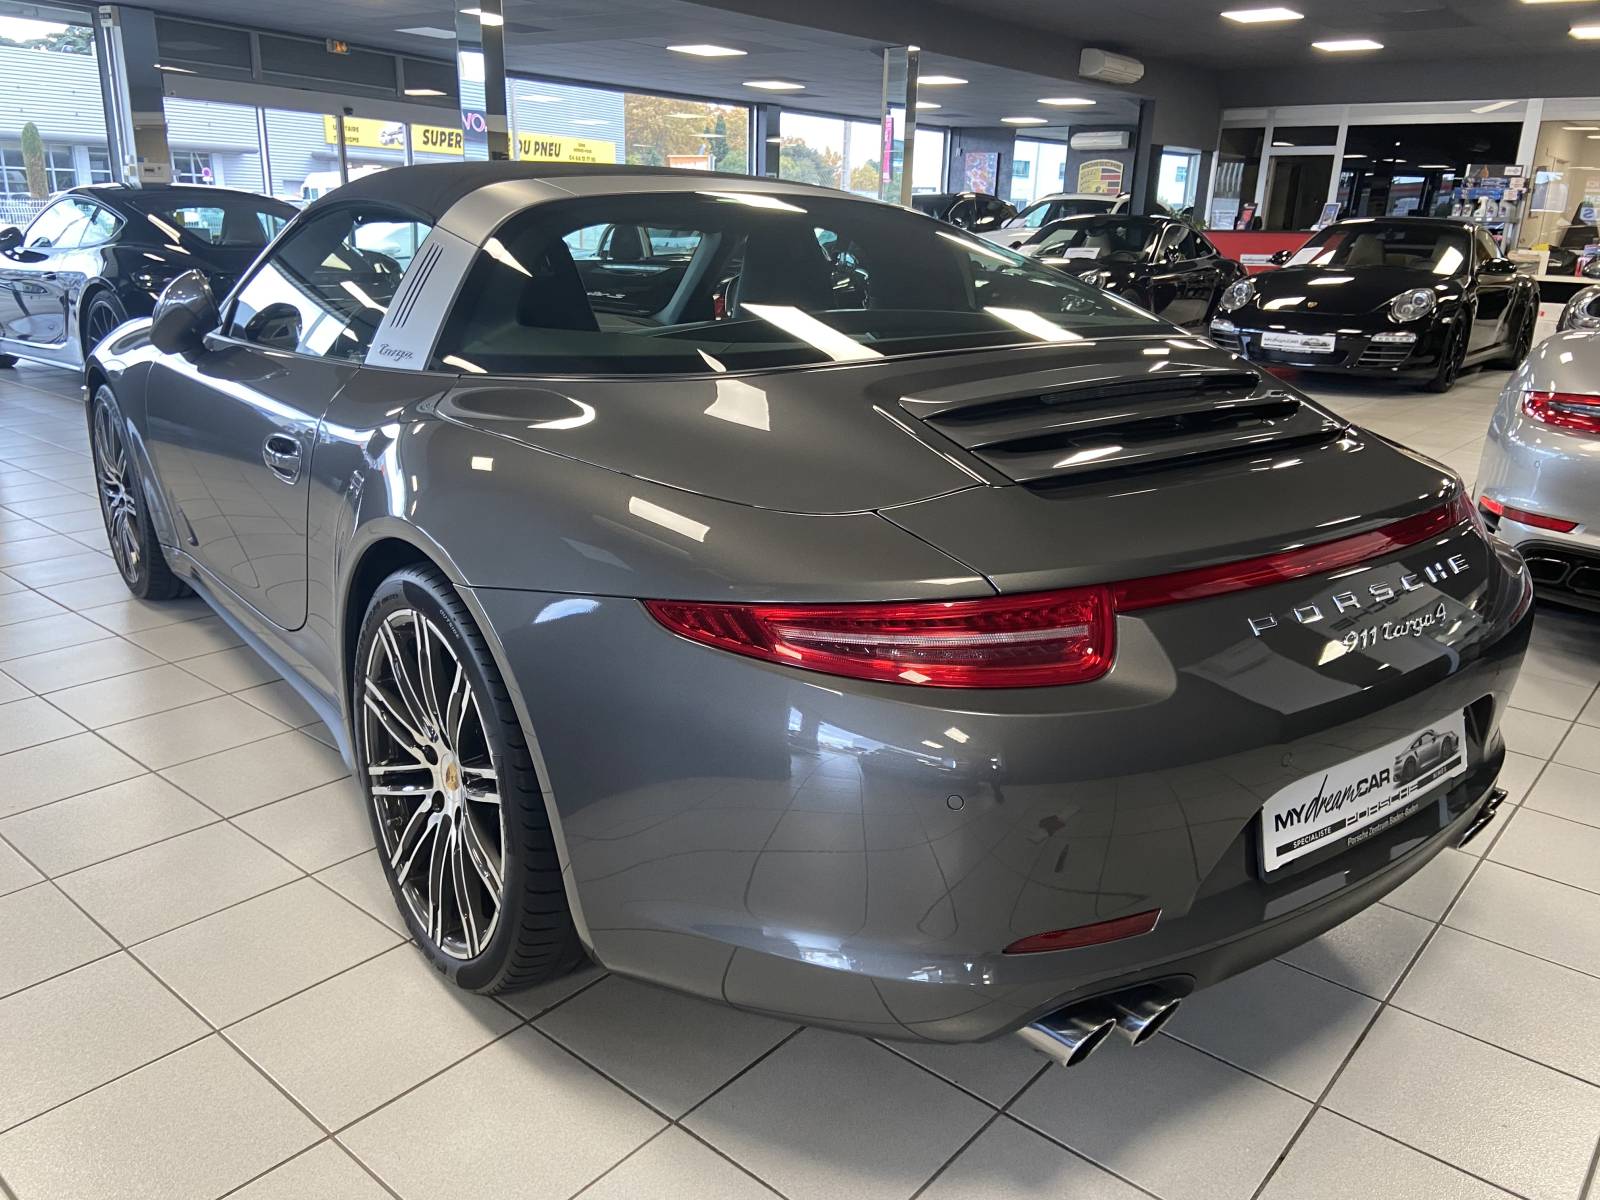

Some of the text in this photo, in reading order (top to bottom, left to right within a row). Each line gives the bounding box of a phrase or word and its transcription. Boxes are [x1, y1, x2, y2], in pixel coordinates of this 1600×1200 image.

[422, 129, 462, 149] SUPER
[533, 141, 562, 158] PNEU
[1248, 553, 1470, 637] PORSCHE
[1343, 625, 1378, 653] 911
[1435, 602, 1448, 627] 4
[1292, 826, 1333, 849] SPECIALISTE
[1347, 831, 1369, 847] Porsche
[1368, 821, 1390, 837] Zentrum
